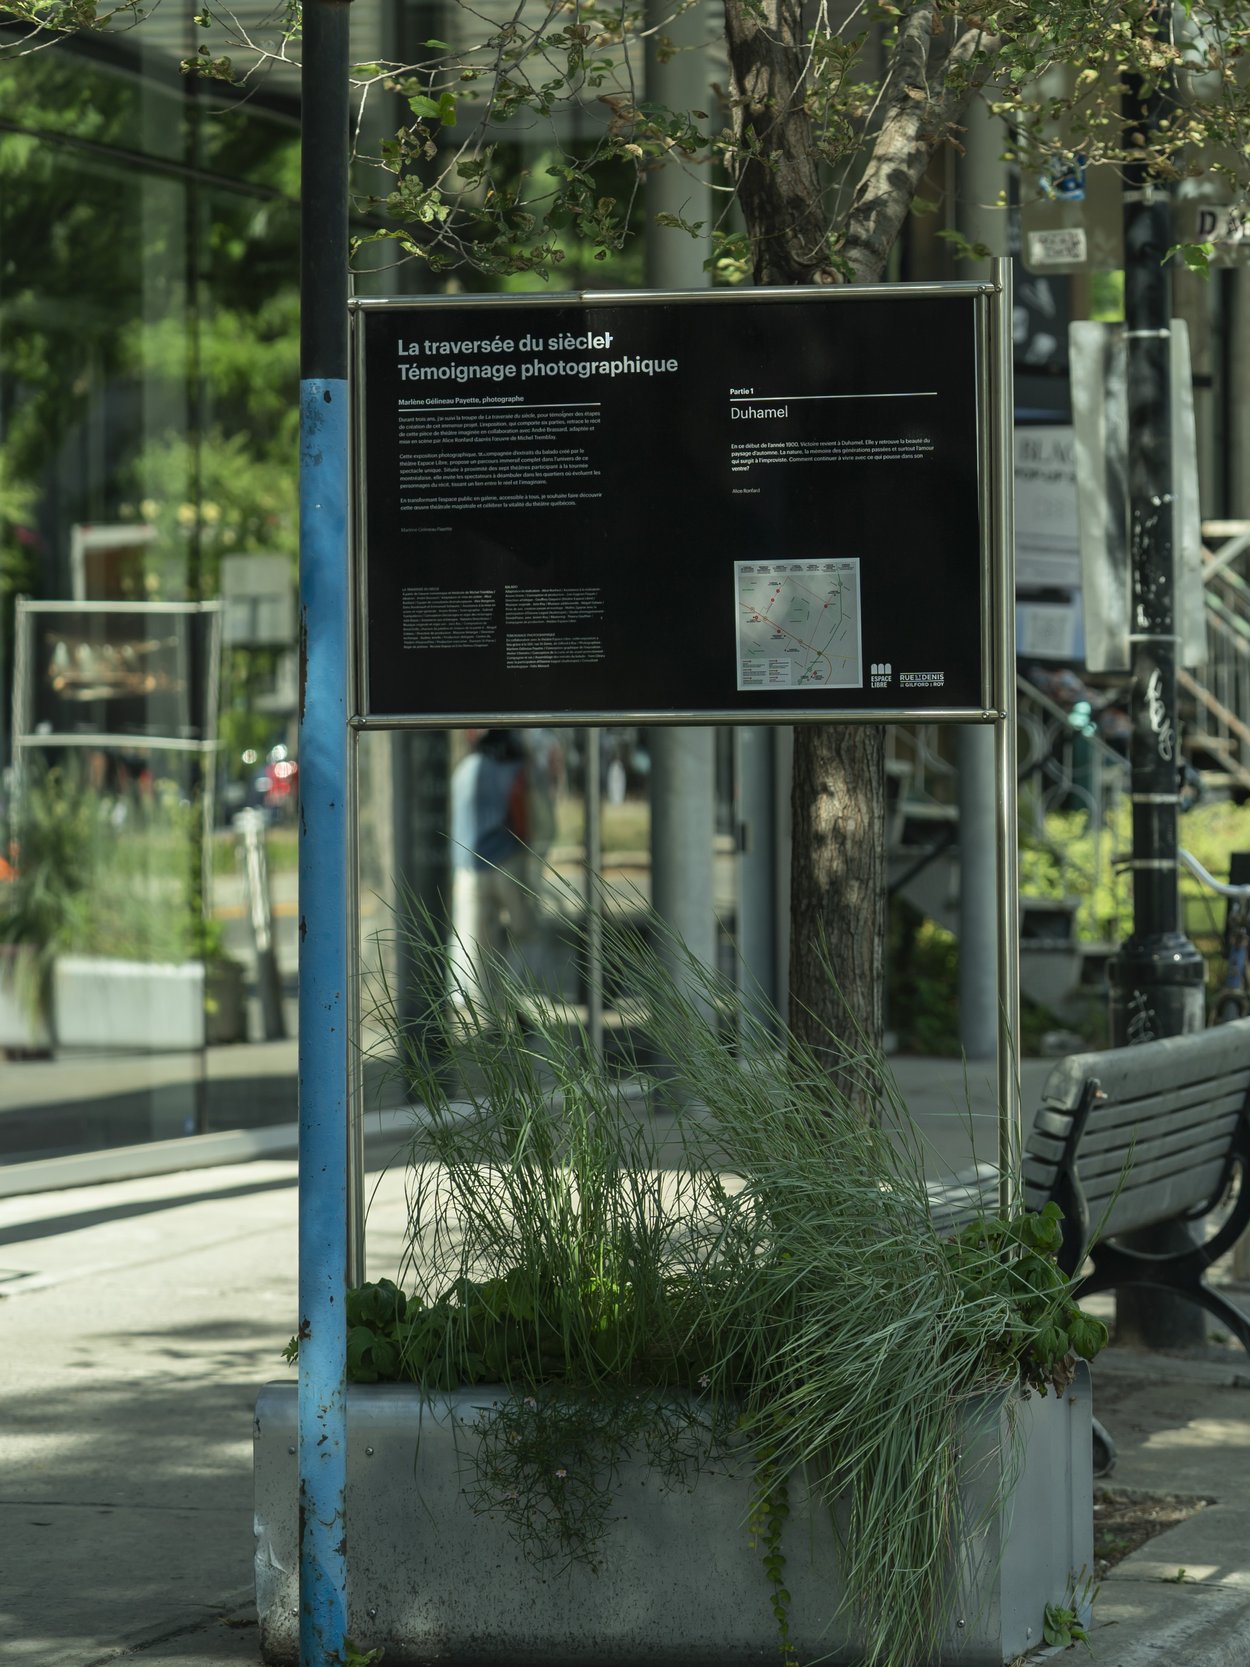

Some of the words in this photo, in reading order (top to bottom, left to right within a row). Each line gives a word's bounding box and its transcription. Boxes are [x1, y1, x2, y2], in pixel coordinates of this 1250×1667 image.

[398, 339, 419, 356] La
[424, 336, 514, 355] traversée
[519, 334, 544, 352] du
[398, 360, 517, 382] Témoignage
[521, 356, 679, 380] photographique
[482, 395, 524, 404] photographe
[731, 405, 788, 420] Duhamel
[842, 446, 871, 455] générations
